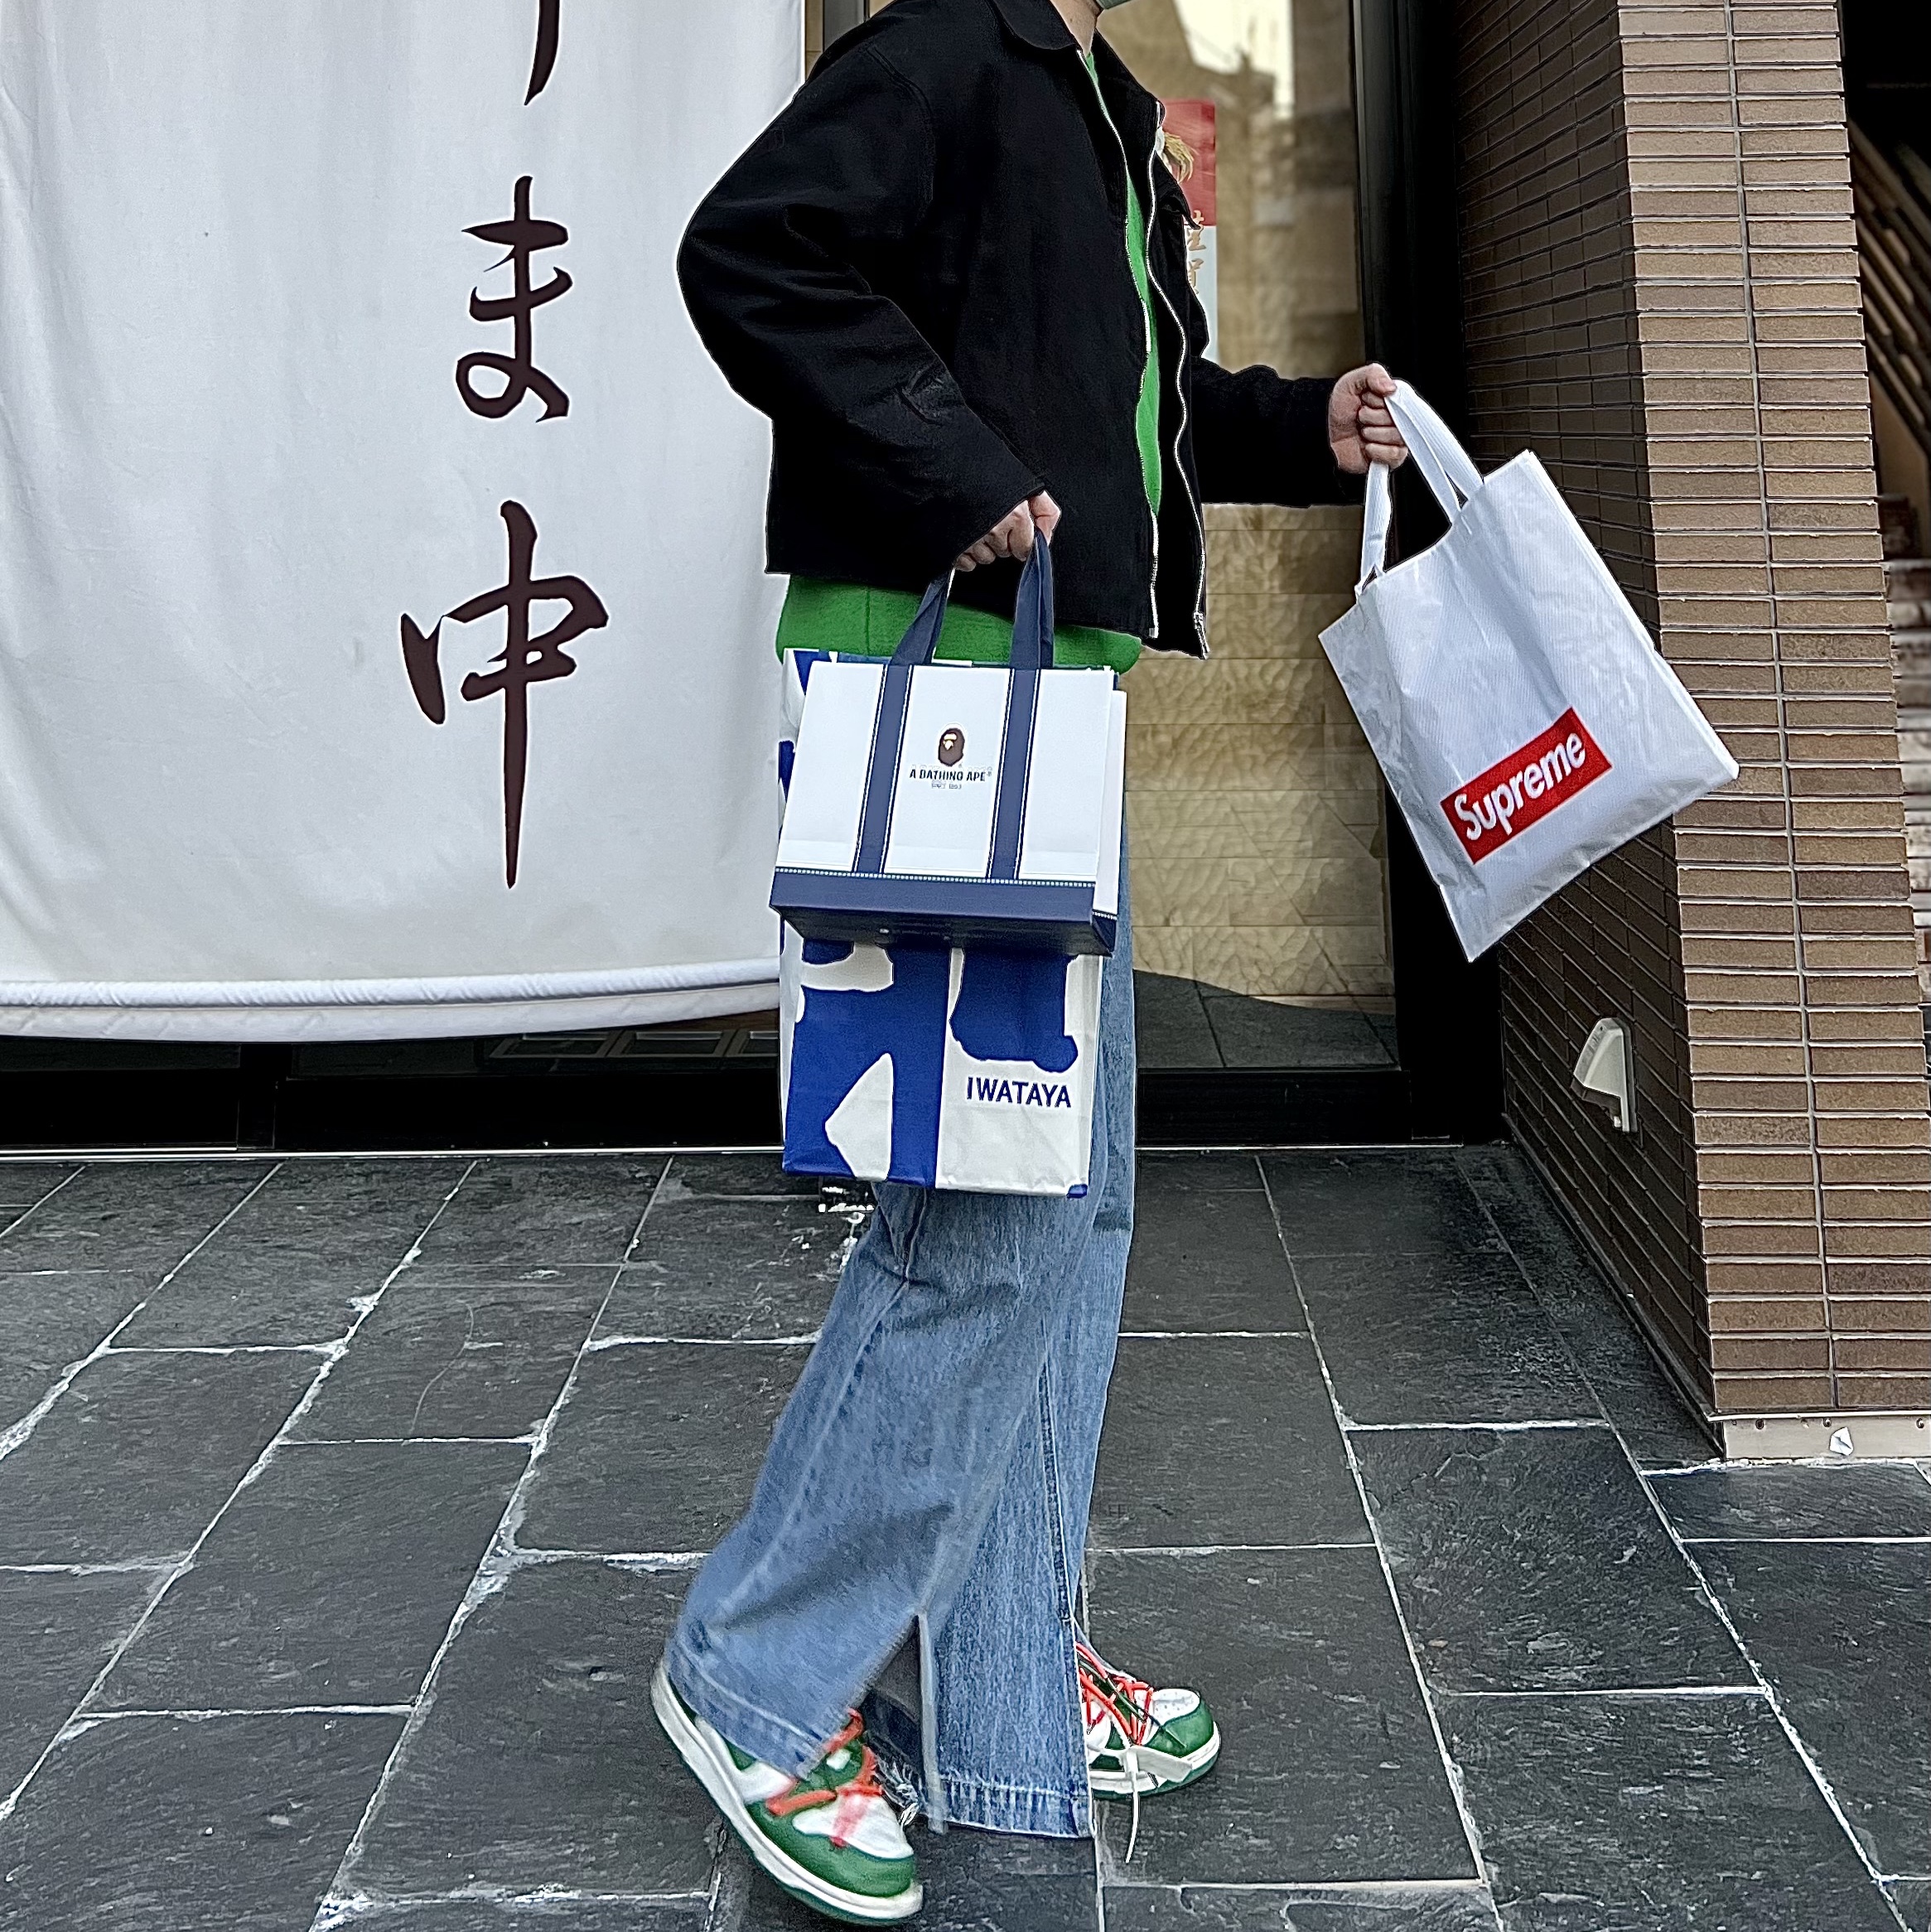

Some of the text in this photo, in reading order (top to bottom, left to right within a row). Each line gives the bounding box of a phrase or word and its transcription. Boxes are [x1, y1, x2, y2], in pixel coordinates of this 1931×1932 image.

[910, 769, 916, 779] A
[1454, 732, 1586, 840] Supreme
[967, 1076, 1071, 1108] IWATAYA
